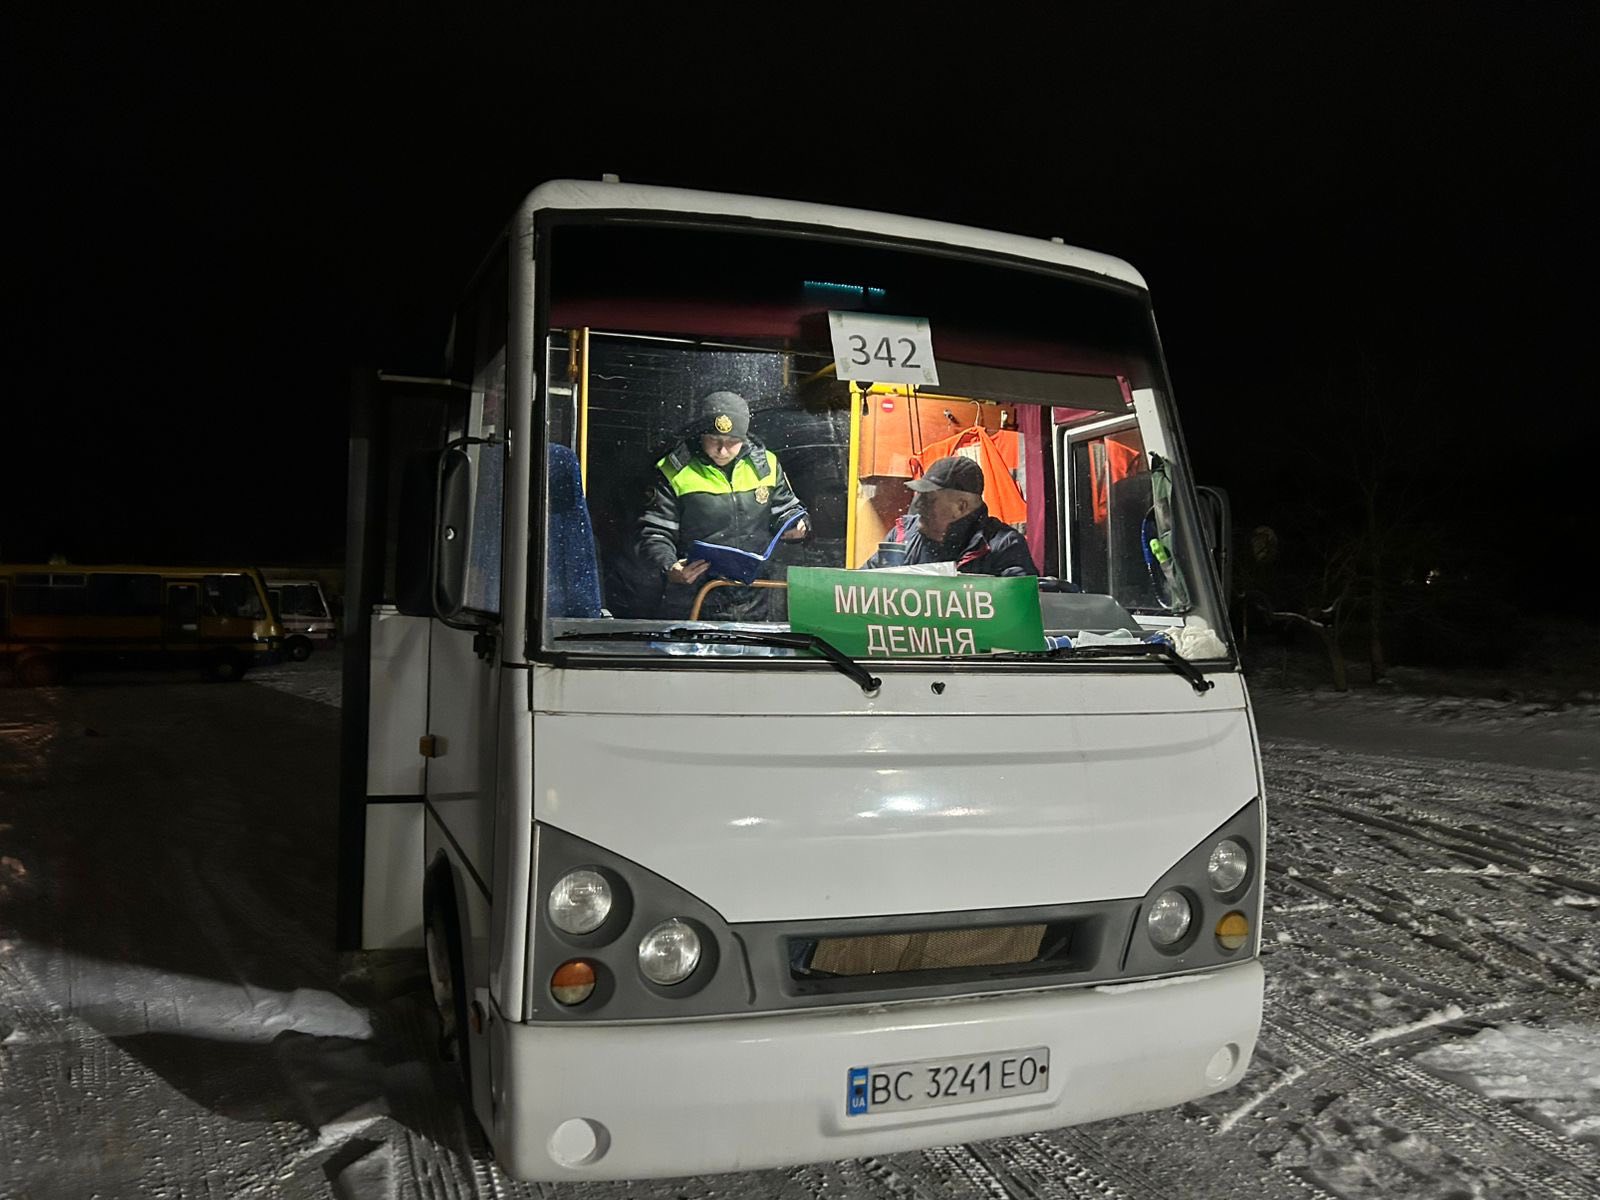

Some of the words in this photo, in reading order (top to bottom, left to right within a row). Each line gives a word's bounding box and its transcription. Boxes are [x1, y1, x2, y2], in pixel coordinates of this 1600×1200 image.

[849, 334, 921, 368] 342
[834, 584, 995, 619] МИКОЛАЇВ
[867, 624, 976, 656] ДЕМНЯ
[871, 1072, 913, 1105] BC
[926, 1061, 991, 1099] 3241
[1001, 1056, 1037, 1088] EO
[852, 1096, 866, 1108] UA
